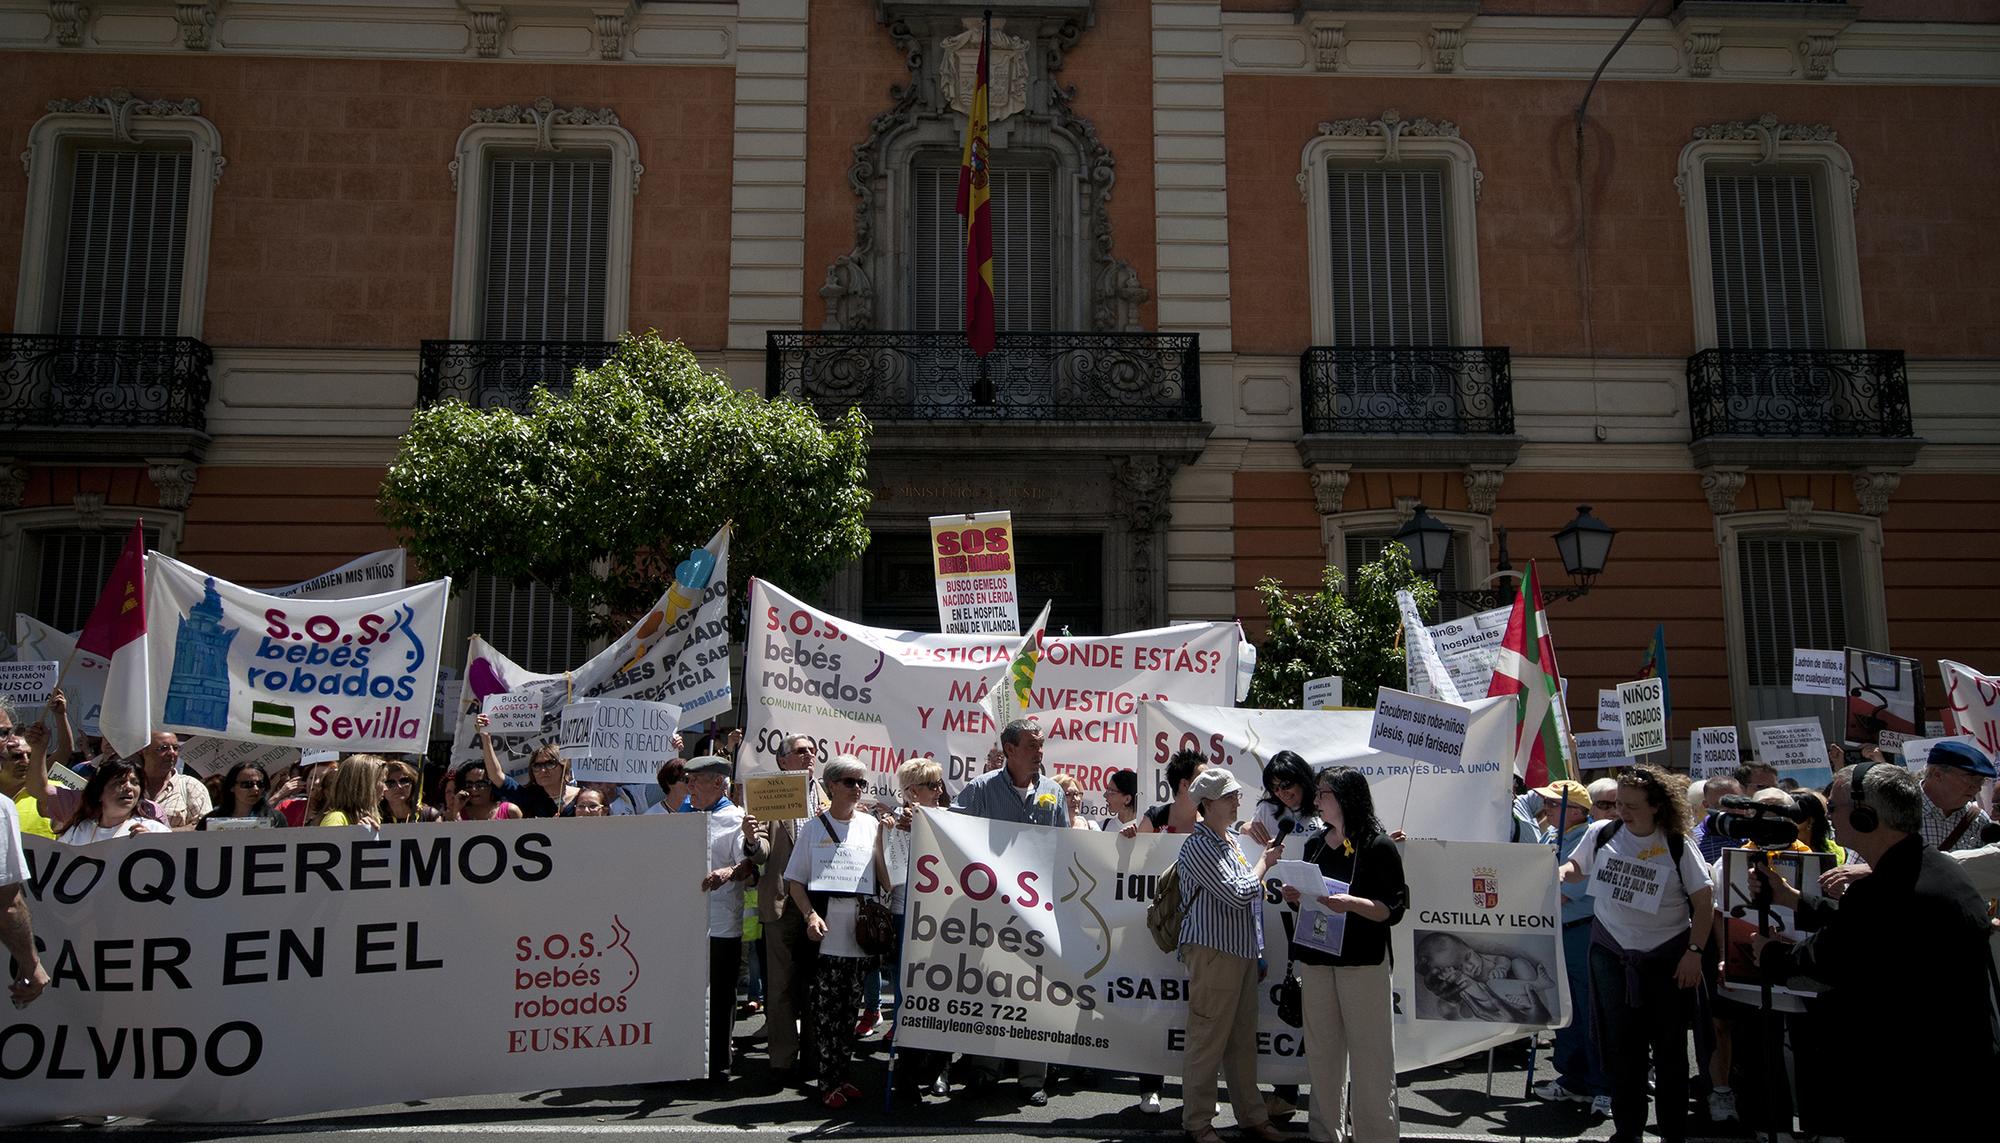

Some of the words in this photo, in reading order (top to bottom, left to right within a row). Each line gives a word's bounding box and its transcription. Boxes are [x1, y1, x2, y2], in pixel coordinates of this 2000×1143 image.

[936, 527, 1009, 555] SOS
[345, 569, 363, 583] MIS
[365, 562, 394, 580] NIÑOS
[946, 579, 972, 592] BUSCO
[973, 577, 1008, 591] GEMELOS
[942, 594, 975, 607] NACIDOS
[976, 592, 987, 604] EN
[952, 608, 963, 620] EN
[963, 607, 973, 619] EL
[973, 605, 1007, 619] HOSPITAL
[264, 608, 390, 646] S.O.S.
[945, 622, 970, 633] ARNAU
[971, 621, 980, 633] DE
[981, 619, 1016, 632] VILANOBA
[256, 636, 371, 668] bebés
[764, 634, 842, 671] bebés
[1441, 629, 1499, 651] hospitales
[1134, 642, 1221, 674] ESTÁS?
[1795, 656, 1814, 668] Ladrón
[1814, 658, 1821, 668] de
[1822, 659, 1838, 671] niños,
[1839, 661, 1843, 671] a
[248, 666, 416, 701] robados
[762, 666, 872, 704] robados
[1793, 672, 1805, 682] con
[1805, 672, 1832, 686] cualquier
[9, 693, 53, 702] AMILIA
[501, 695, 528, 703] BUSCO
[1623, 684, 1660, 704] NIÑOS
[491, 703, 525, 712] AGOSTO
[513, 712, 536, 720] RAMON
[598, 705, 634, 729] ODOS
[642, 708, 669, 731] LOS
[760, 695, 812, 714] COMUNITAT
[815, 705, 883, 724] VALENCIANA
[917, 706, 935, 729] Y
[1378, 700, 1412, 721] Encubren
[1412, 711, 1426, 724] sus
[1427, 714, 1466, 735] roba-niños.
[1625, 706, 1661, 727] ROBADOS
[308, 705, 420, 739] Sevilla
[590, 728, 619, 749] IÑOS
[624, 732, 674, 753] ROBADOS
[1374, 722, 1406, 743] ¡Jesús,
[1406, 731, 1424, 748] qué
[1425, 735, 1463, 757] fariseos!
[1628, 729, 1663, 752] ¡JUSTICIA!
[1702, 730, 1735, 745] NIÑOS
[576, 756, 619, 772] TAMBIÉN
[626, 759, 648, 774] SON
[948, 755, 977, 781] DE
[1376, 766, 1385, 776] A
[1387, 763, 1430, 775] TRAVÉS
[1433, 766, 1447, 775] DE
[1467, 760, 1500, 774] UNIÓN
[1704, 749, 1737, 763] ROBADOS
[1791, 757, 1822, 765] ROBADO
[117, 832, 554, 906] QUEREMOS
[914, 854, 1054, 912] S.O.S.
[910, 901, 1046, 957] bebés
[1419, 911, 1491, 926] CASTILLA
[1495, 914, 1505, 926] Y
[1510, 914, 1554, 928] LEON
[222, 925, 326, 986] EN
[354, 920, 444, 975] EL
[515, 931, 604, 962] S.O.S.
[515, 963, 602, 991] bebés
[906, 952, 1097, 1011] robados
[514, 991, 628, 1019] robados
[904, 995, 940, 1012] 608
[946, 998, 984, 1018] 652
[991, 1003, 1028, 1022] 722
[506, 1022, 654, 1055] EUSKADI
[901, 1014, 1110, 1049] castillayleon@sos-bebesrobados.es
[0, 1020, 264, 1080] OLVIDO
